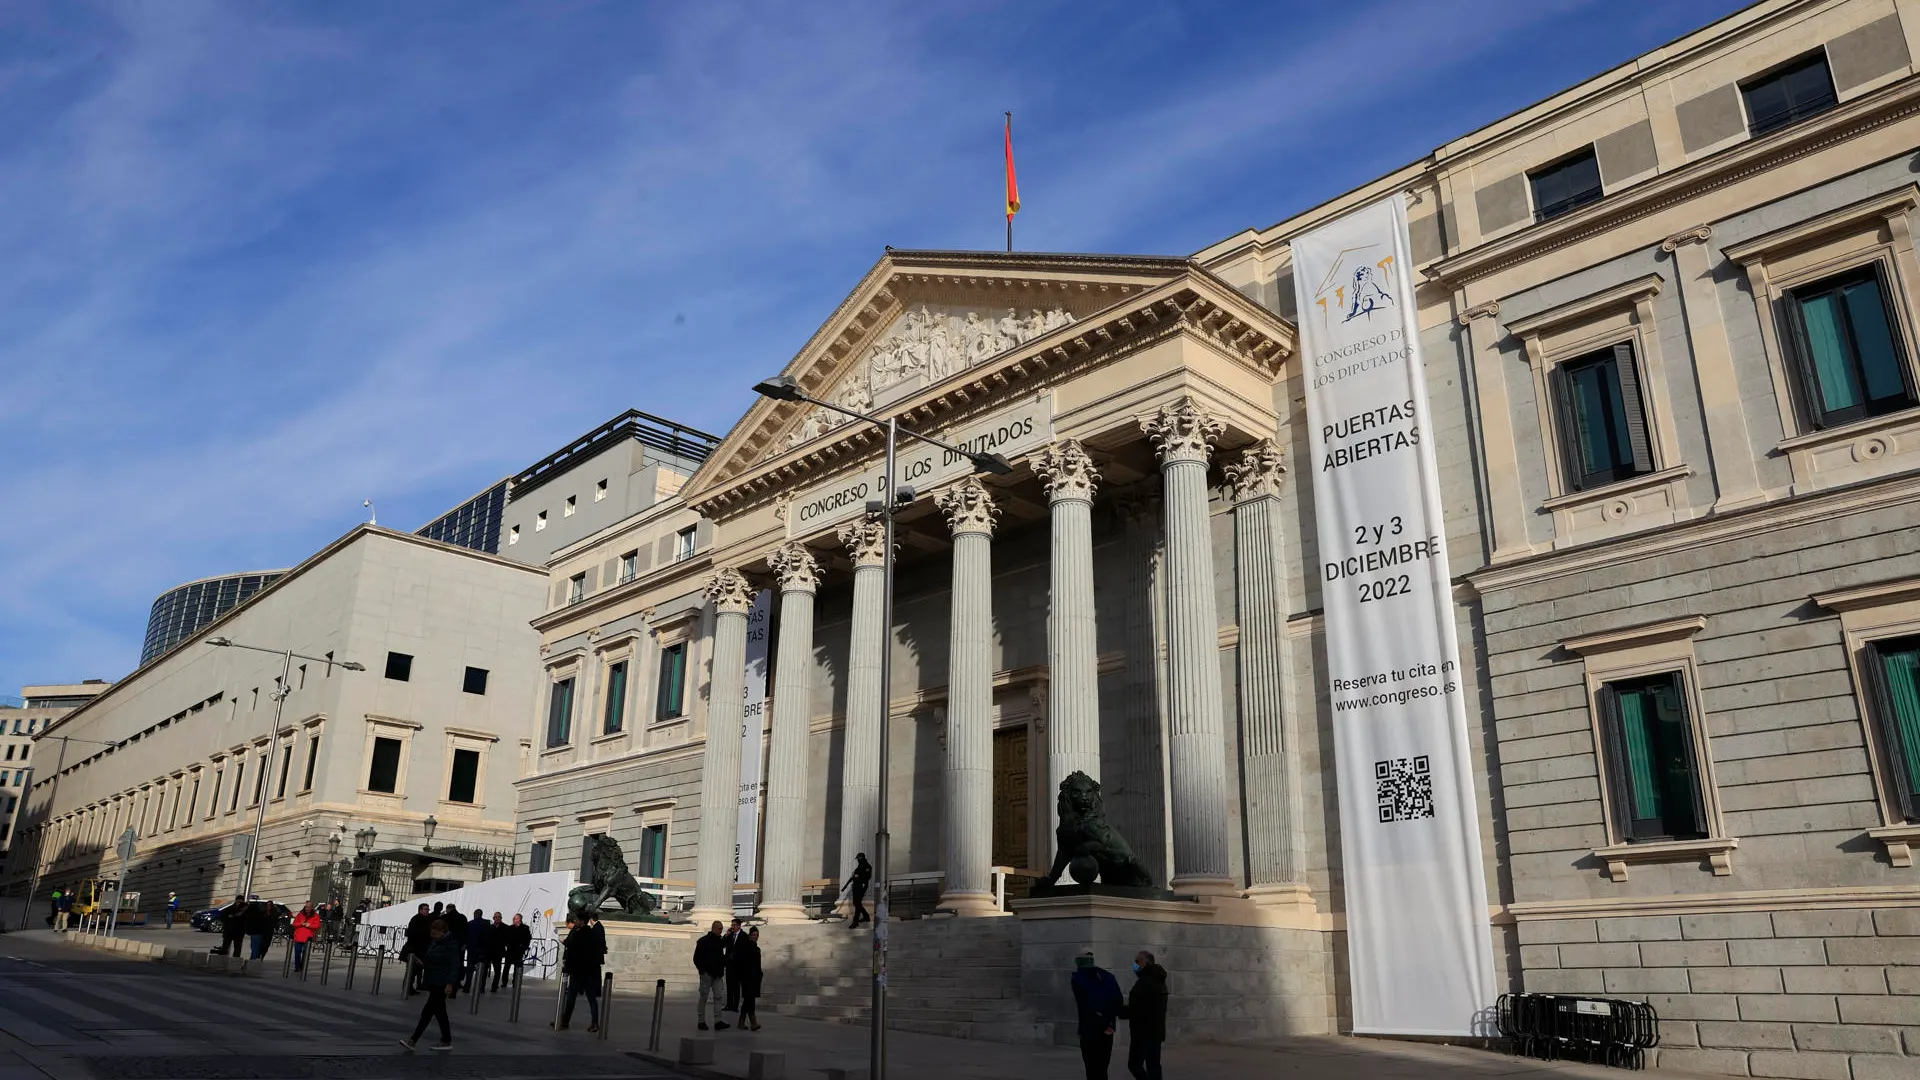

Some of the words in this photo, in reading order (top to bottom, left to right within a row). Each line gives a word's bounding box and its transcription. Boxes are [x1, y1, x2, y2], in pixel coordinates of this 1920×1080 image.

[1313, 372, 1336, 390] LOS
[1337, 344, 1416, 381] DIPUTADOS
[1315, 333, 1387, 368] CONGRESO
[1323, 399, 1416, 445] PUERTAS
[1322, 425, 1421, 473] ABIERTAS
[800, 482, 869, 521] CONGRESO
[903, 457, 932, 482] LOS
[1355, 525, 1369, 545] 2
[1372, 524, 1385, 546] y
[1390, 515, 1403, 535] 3
[1325, 535, 1441, 582] DICIEMBRE
[1358, 574, 1412, 603] 2022
[1333, 672, 1388, 692] Reserva
[1390, 669, 1406, 682] tu
[1408, 662, 1437, 679] cita
[1440, 659, 1455, 674] en
[1335, 681, 1457, 712] www.congreso.es
